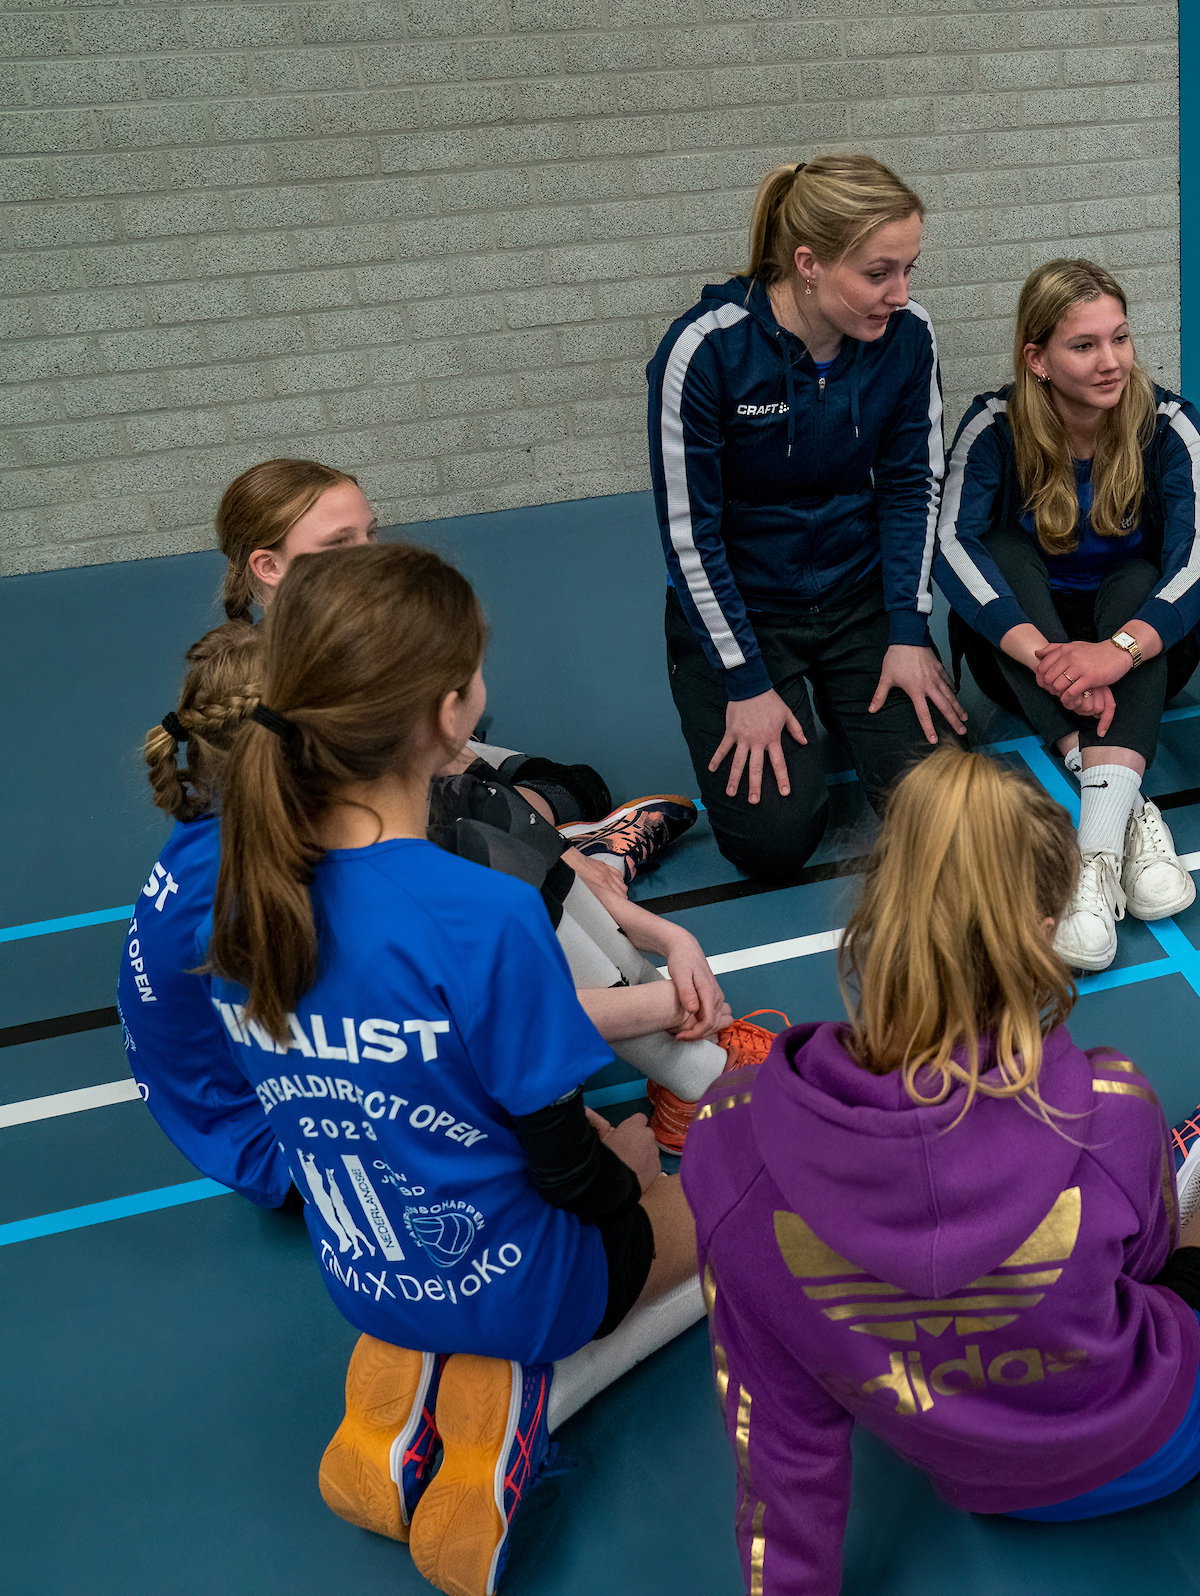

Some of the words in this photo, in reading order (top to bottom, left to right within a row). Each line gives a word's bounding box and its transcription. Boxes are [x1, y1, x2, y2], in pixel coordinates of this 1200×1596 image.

[737, 404, 779, 416] CRAFT
[211, 997, 450, 1064] INALIST
[298, 1116, 378, 1142] 2023
[408, 1104, 489, 1149] OPEN
[856, 1343, 1092, 1415] didas
